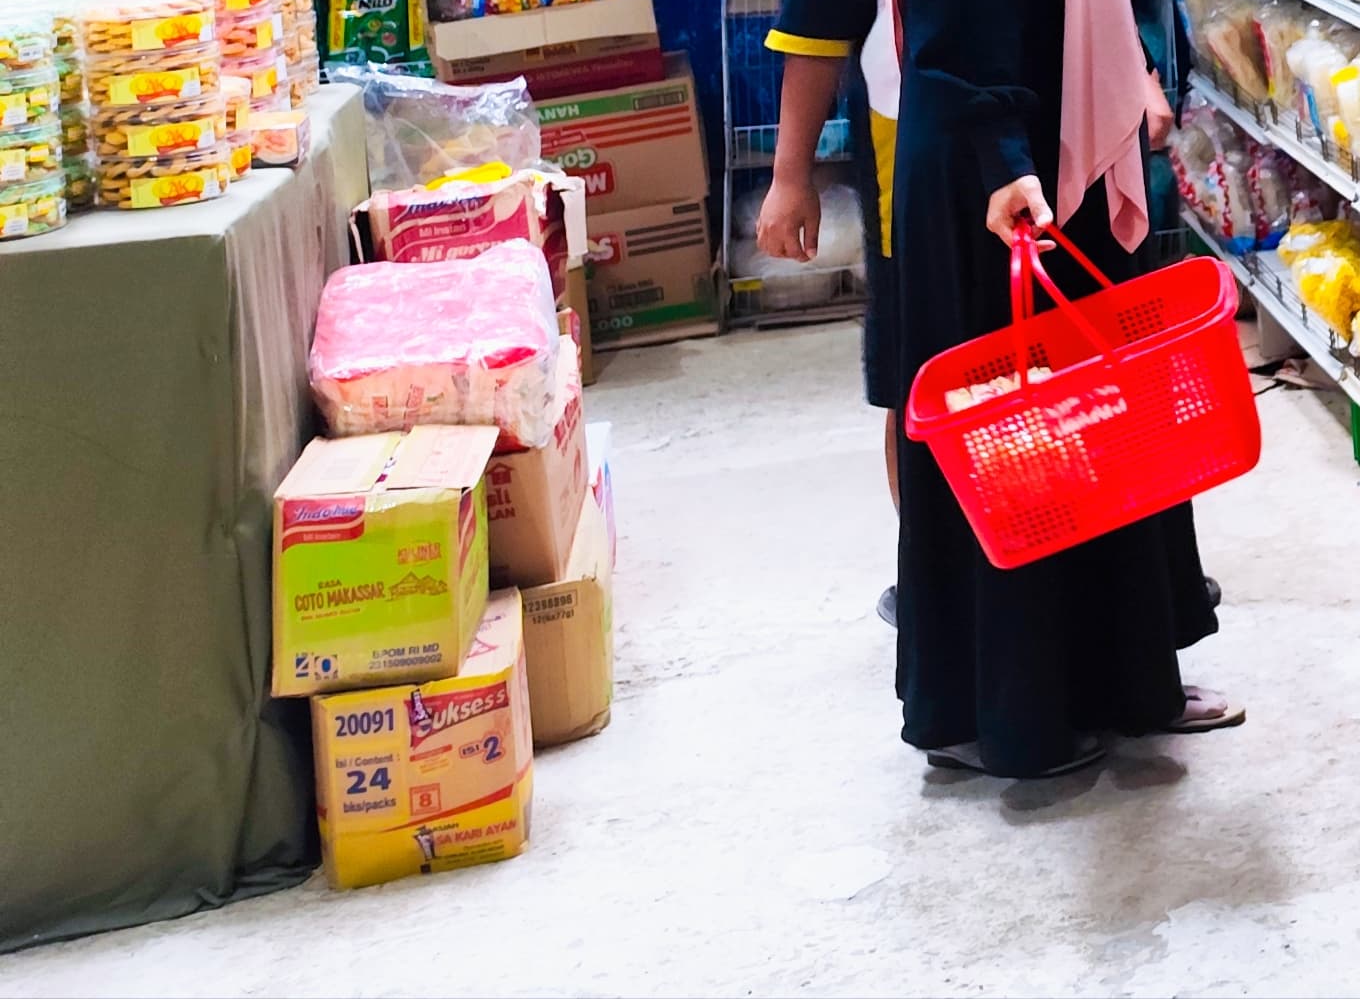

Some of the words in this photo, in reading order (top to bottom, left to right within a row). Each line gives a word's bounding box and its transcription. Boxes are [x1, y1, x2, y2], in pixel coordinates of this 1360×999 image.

[326, 581, 385, 607] MAKASSAR
[335, 707, 395, 738] 20091
[354, 753, 394, 768] Content
[346, 767, 392, 795] 24
[343, 797, 397, 814] bks/packs
